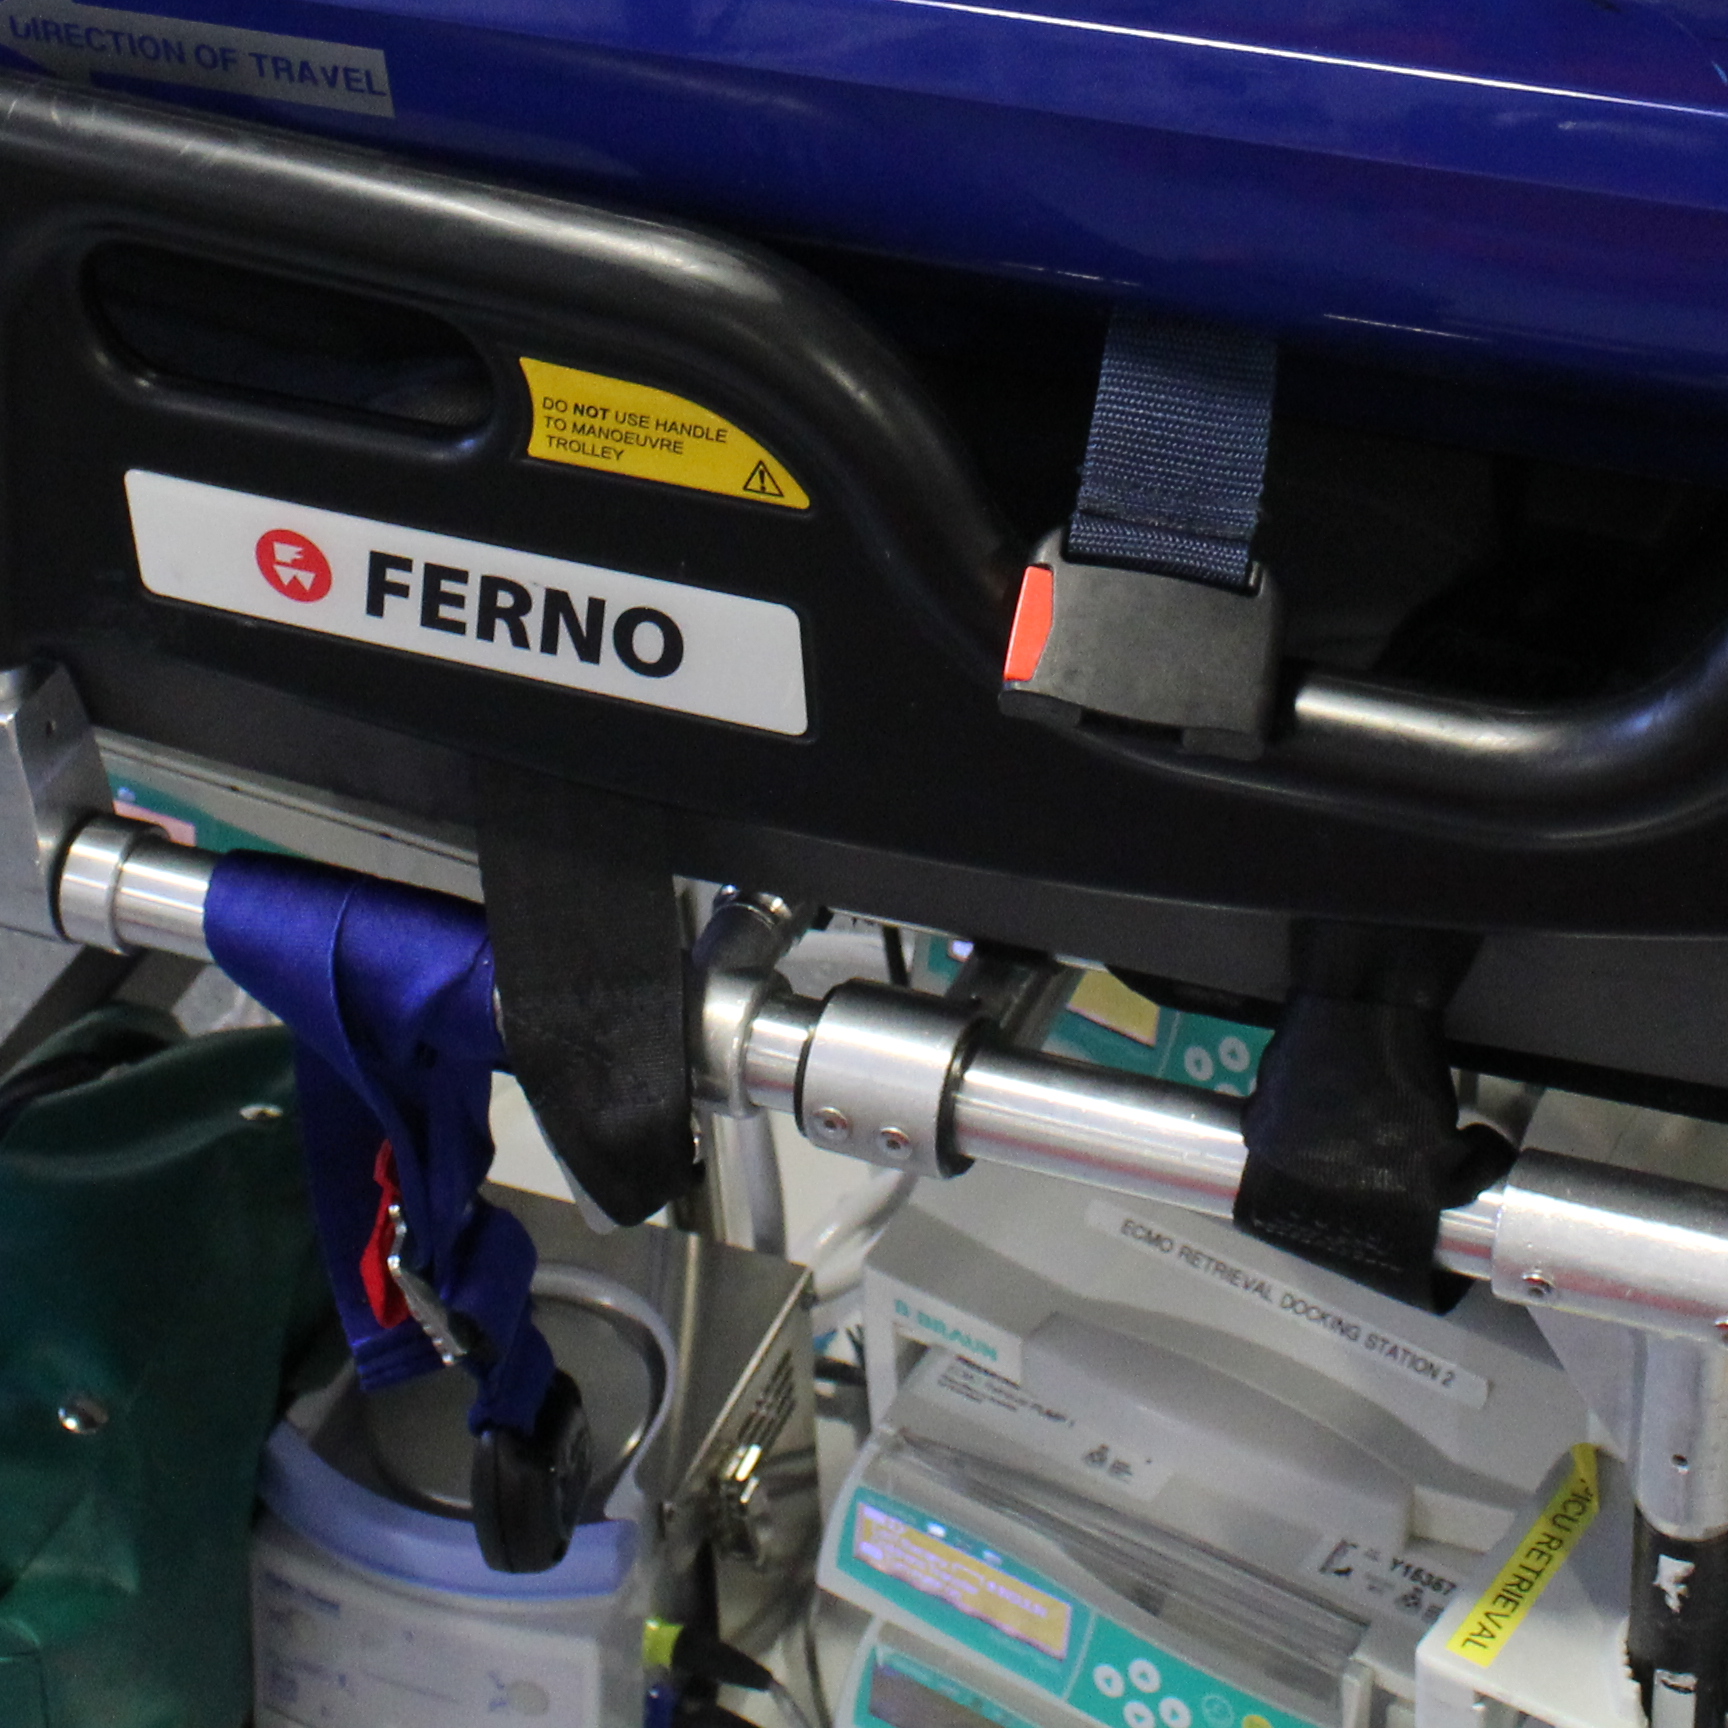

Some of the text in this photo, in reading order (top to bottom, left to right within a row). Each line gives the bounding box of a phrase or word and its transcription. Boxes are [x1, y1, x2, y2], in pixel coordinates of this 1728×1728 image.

[9, 15, 388, 97] DIRECTION OF TRAVEL
[542, 396, 729, 444] DO NOT USE HANDLE
[543, 416, 684, 455] TO MANOEUVRE
[545, 435, 625, 461] TROLLEY
[365, 549, 686, 679] FERNO
[1120, 1218, 1456, 1389] ECMO RETRIEVAL DOCKING STATION 2
[1462, 1532, 1564, 1650] RETRIEVAL
